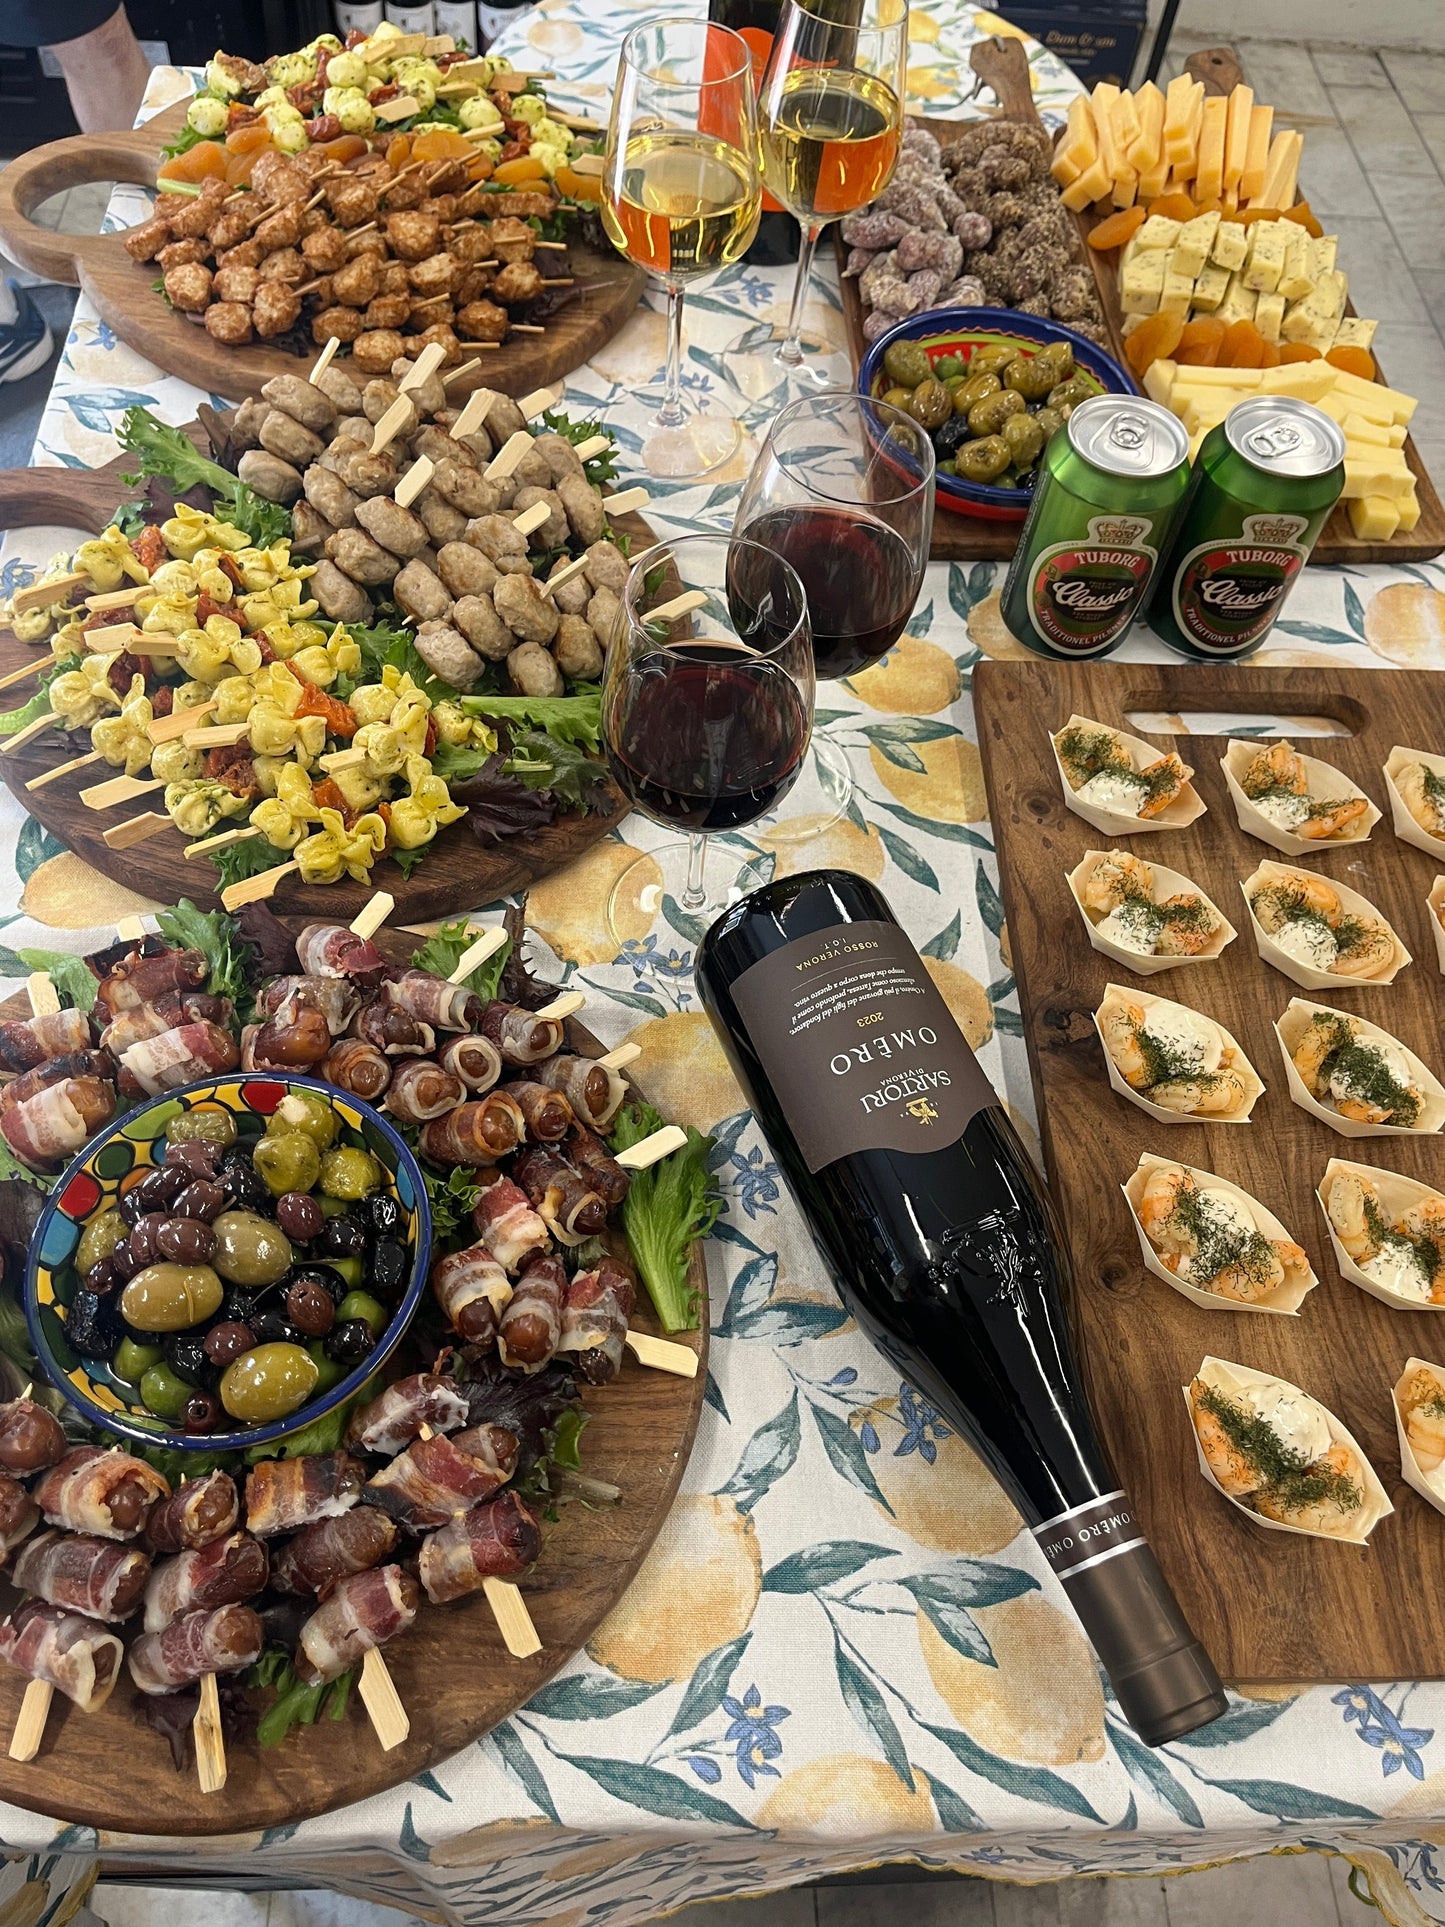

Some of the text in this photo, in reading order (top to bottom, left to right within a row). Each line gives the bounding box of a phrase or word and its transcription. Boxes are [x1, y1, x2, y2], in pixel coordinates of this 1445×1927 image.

[1075, 552, 1141, 568] TUBORG
[1226, 550, 1293, 567] TUBORG
[1053, 582, 1134, 607] Classic
[1201, 580, 1283, 605] Classic
[1040, 610, 1090, 644] TRADITIONEL
[1186, 608, 1235, 642] TRADITIONEL
[795, 941, 878, 970] ROSSO VERONA
[837, 975, 859, 987] corpo
[858, 970, 876, 980] dona
[875, 968, 888, 978] che
[871, 978, 889, 987] come
[809, 982, 833, 1000] questo
[814, 987, 847, 1010] profondo
[857, 987, 884, 1002] giovane
[831, 1000, 847, 1014] figli
[846, 997, 858, 1008] dei
[796, 1004, 815, 1019] come
[820, 1007, 833, 1020] del
[856, 1012, 884, 1027] 2023
[790, 1014, 797, 1026] il
[830, 1027, 936, 1075] OMÈRO
[880, 1069, 915, 1085] VERONA
[860, 1070, 951, 1113] SARTORI
[1078, 1513, 1129, 1542] OMÈRO
